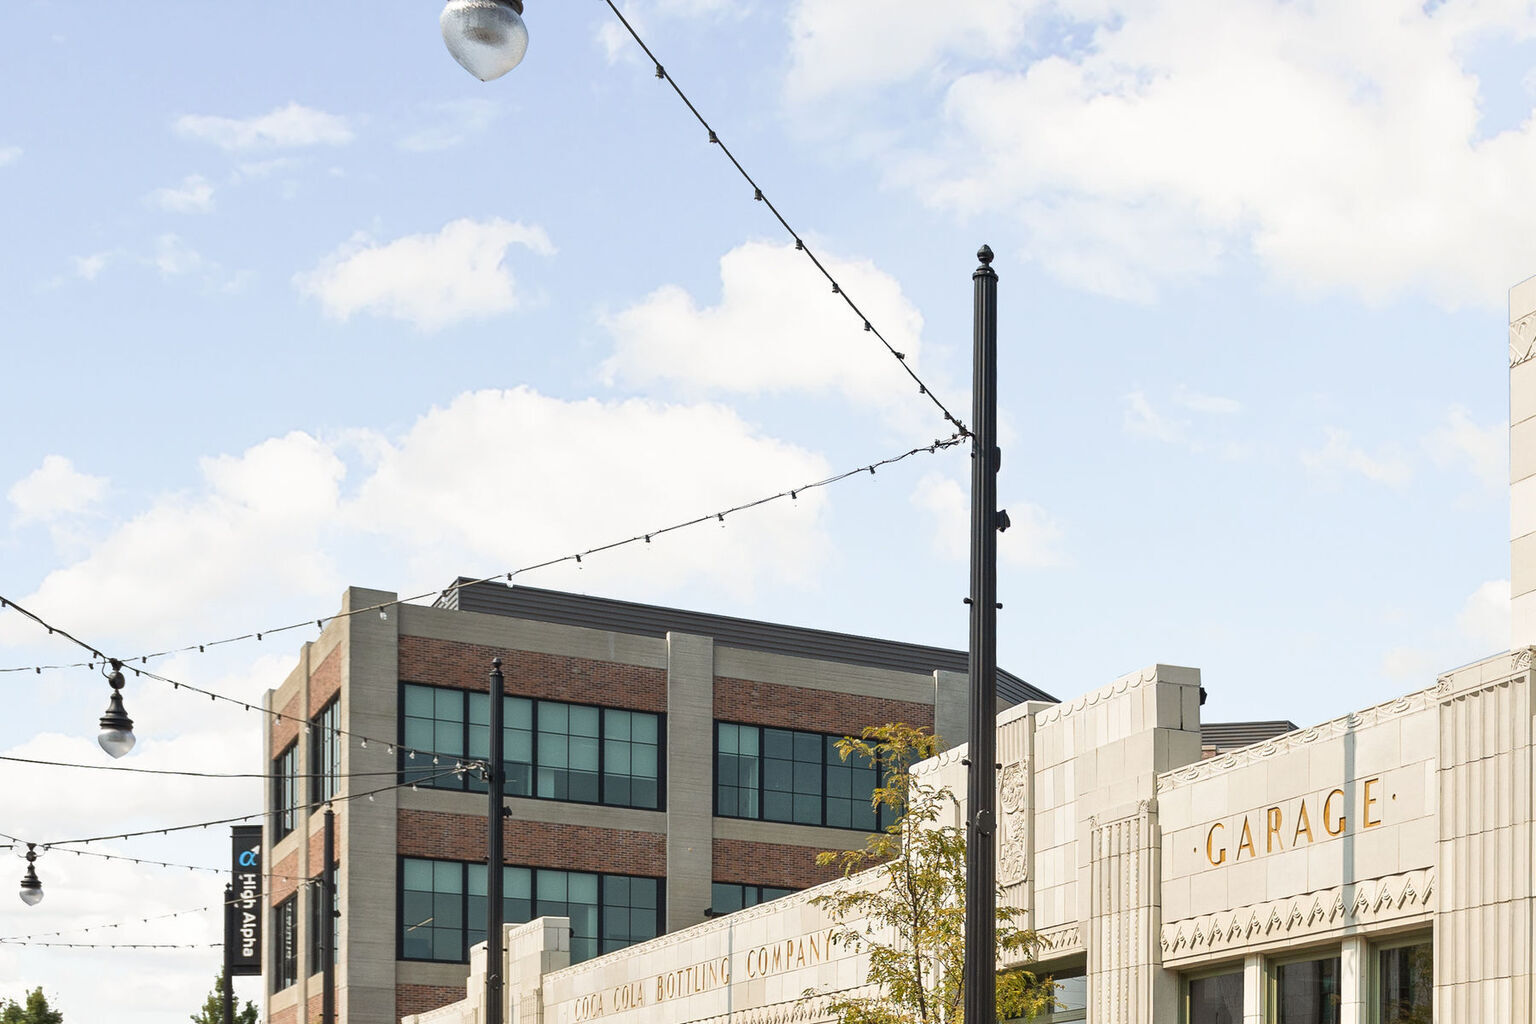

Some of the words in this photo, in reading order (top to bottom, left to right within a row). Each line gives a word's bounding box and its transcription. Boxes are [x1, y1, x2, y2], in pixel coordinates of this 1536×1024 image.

[1206, 777, 1382, 867] GARAGE
[240, 874, 257, 909] High
[240, 912, 257, 957] Alpha
[574, 993, 604, 1022] COCA
[614, 982, 644, 1012] COLA
[656, 957, 730, 1002] BOTTLING
[747, 928, 834, 979] COMPANY
